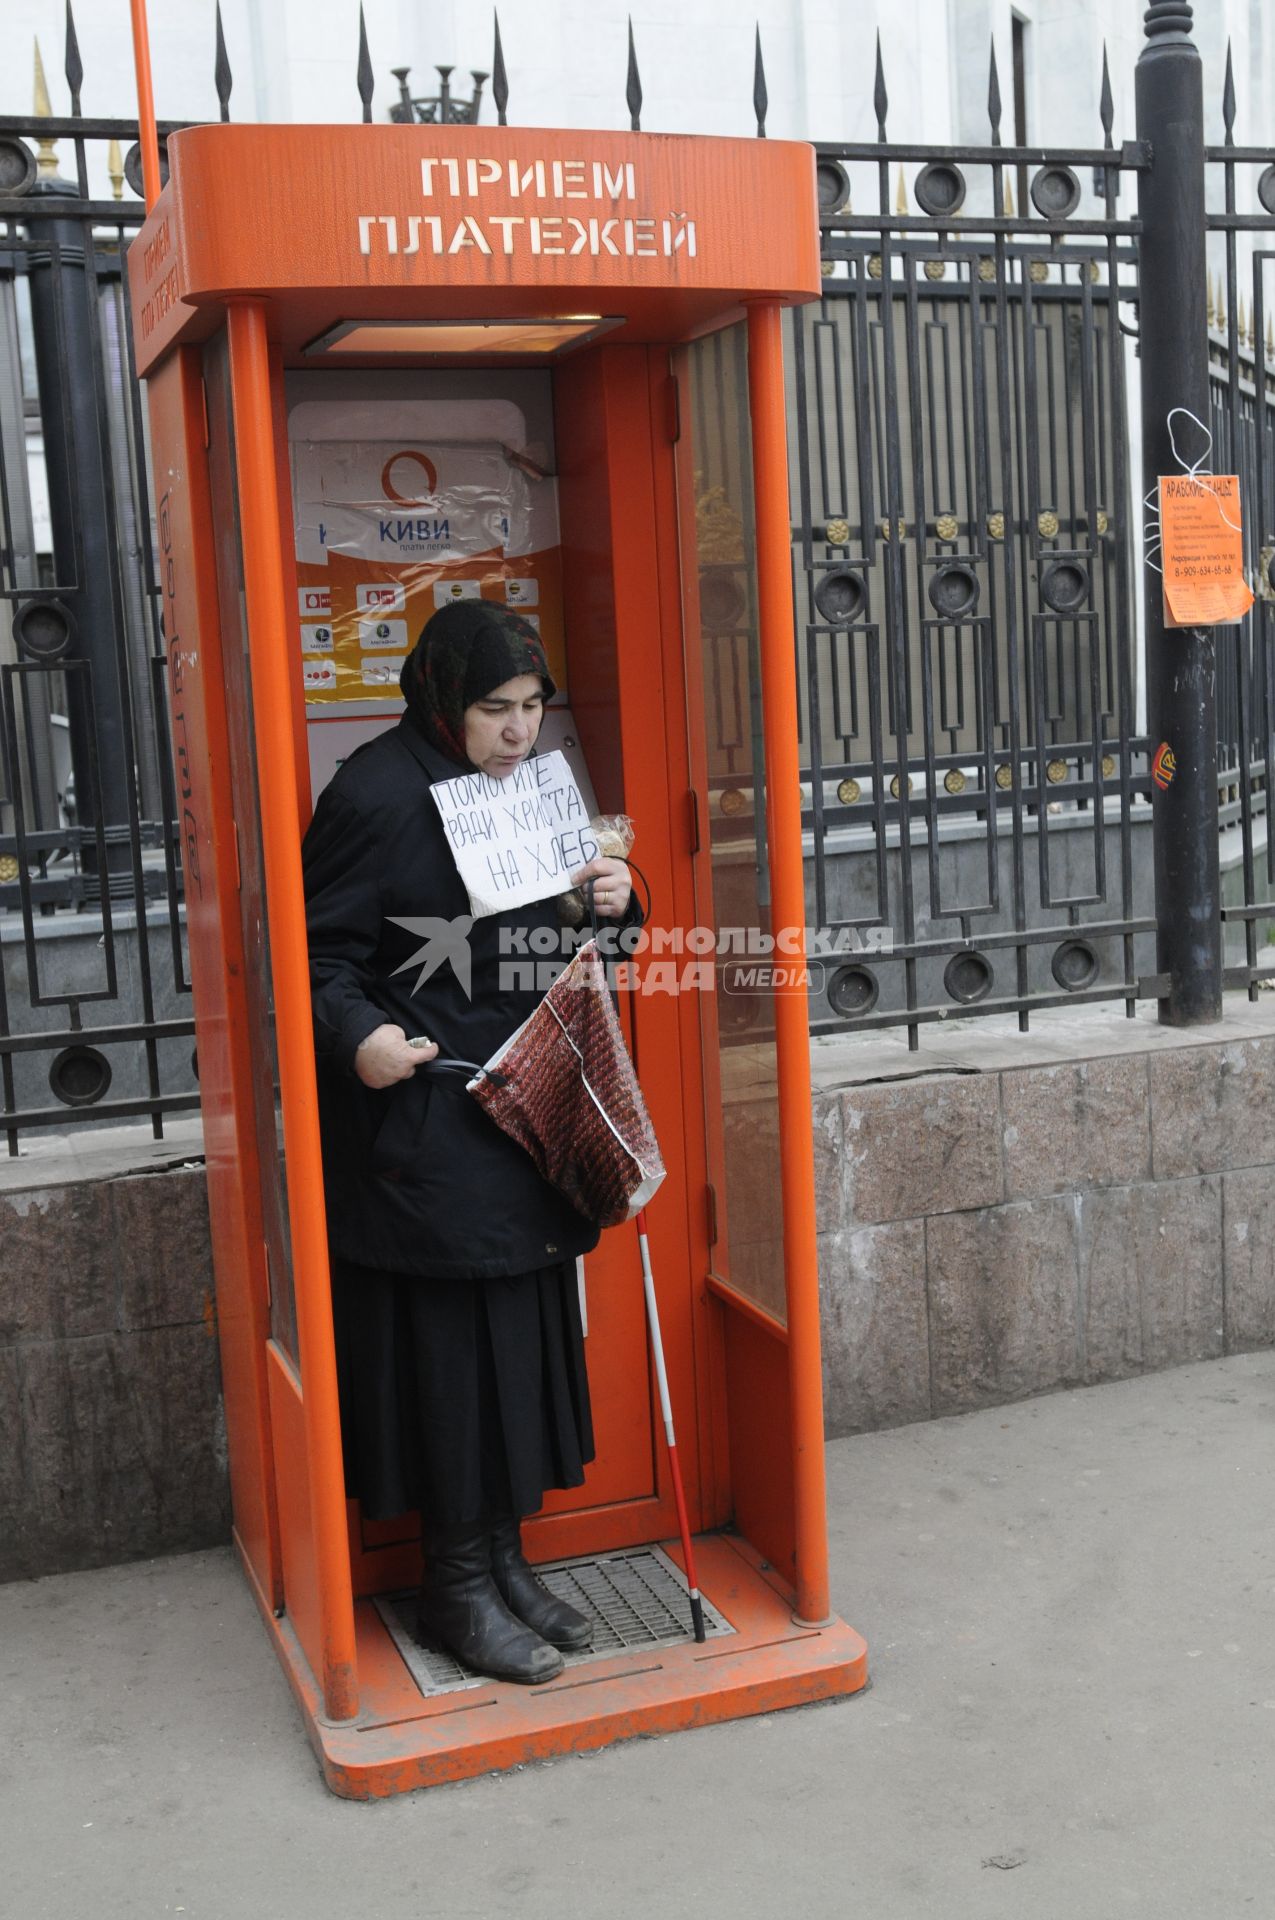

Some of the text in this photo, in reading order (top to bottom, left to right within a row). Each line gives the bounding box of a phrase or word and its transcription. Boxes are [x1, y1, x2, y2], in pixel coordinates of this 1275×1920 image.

[421, 158, 636, 199] ПРИЕМ
[357, 212, 698, 257] ПЛАТЕЖЕЙ
[1166, 480, 1205, 498] АРАБСКИЕ
[379, 519, 450, 543] КИВИ
[447, 785, 582, 849] РАДИ ХРИСТА
[486, 826, 598, 892] НА ХЛЕБ
